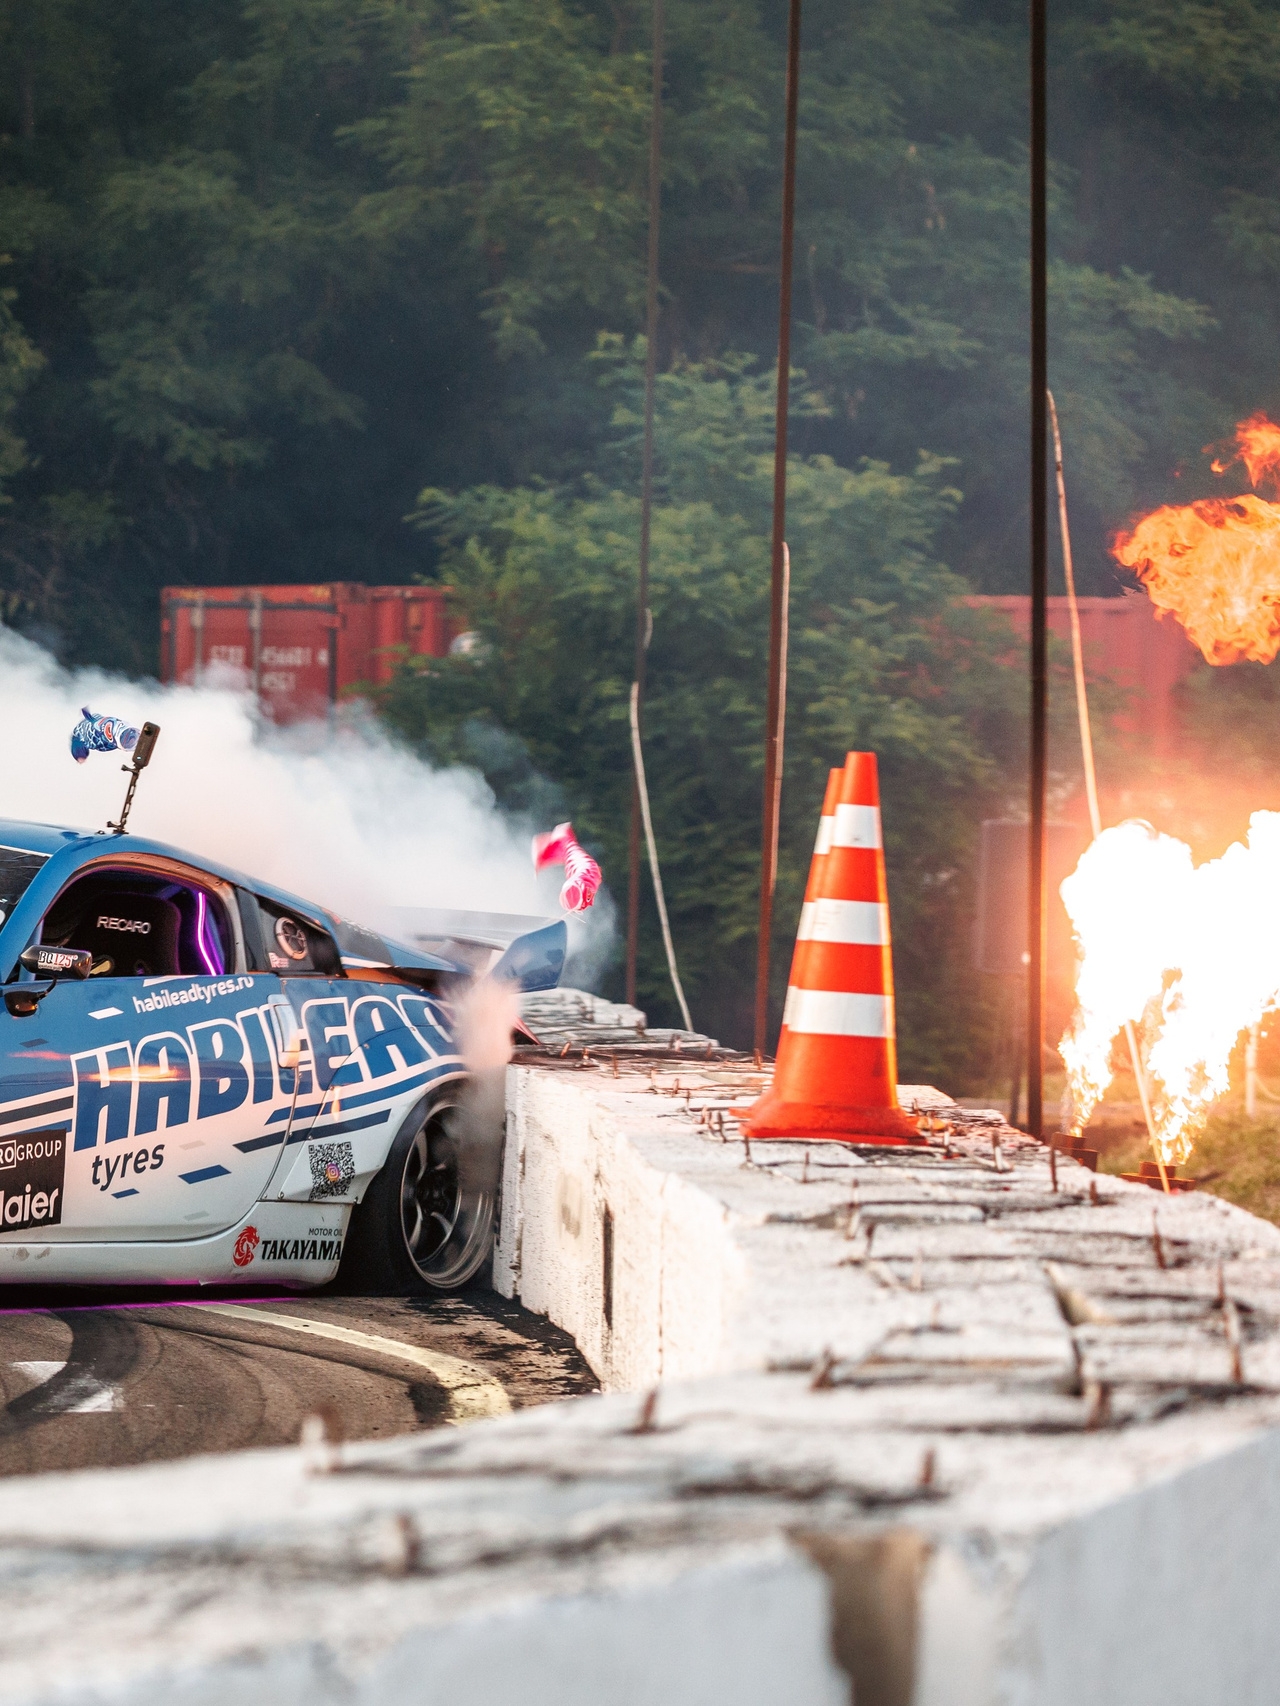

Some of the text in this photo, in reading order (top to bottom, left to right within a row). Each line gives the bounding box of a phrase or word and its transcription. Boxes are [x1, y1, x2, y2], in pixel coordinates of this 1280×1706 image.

[96, 915, 152, 935] RECARO
[132, 976, 255, 1014] habileadtyres.ru
[90, 1143, 165, 1191] tyres
[308, 1227, 333, 1236] MOTOR
[261, 1239, 342, 1260] TAKAYAMA
